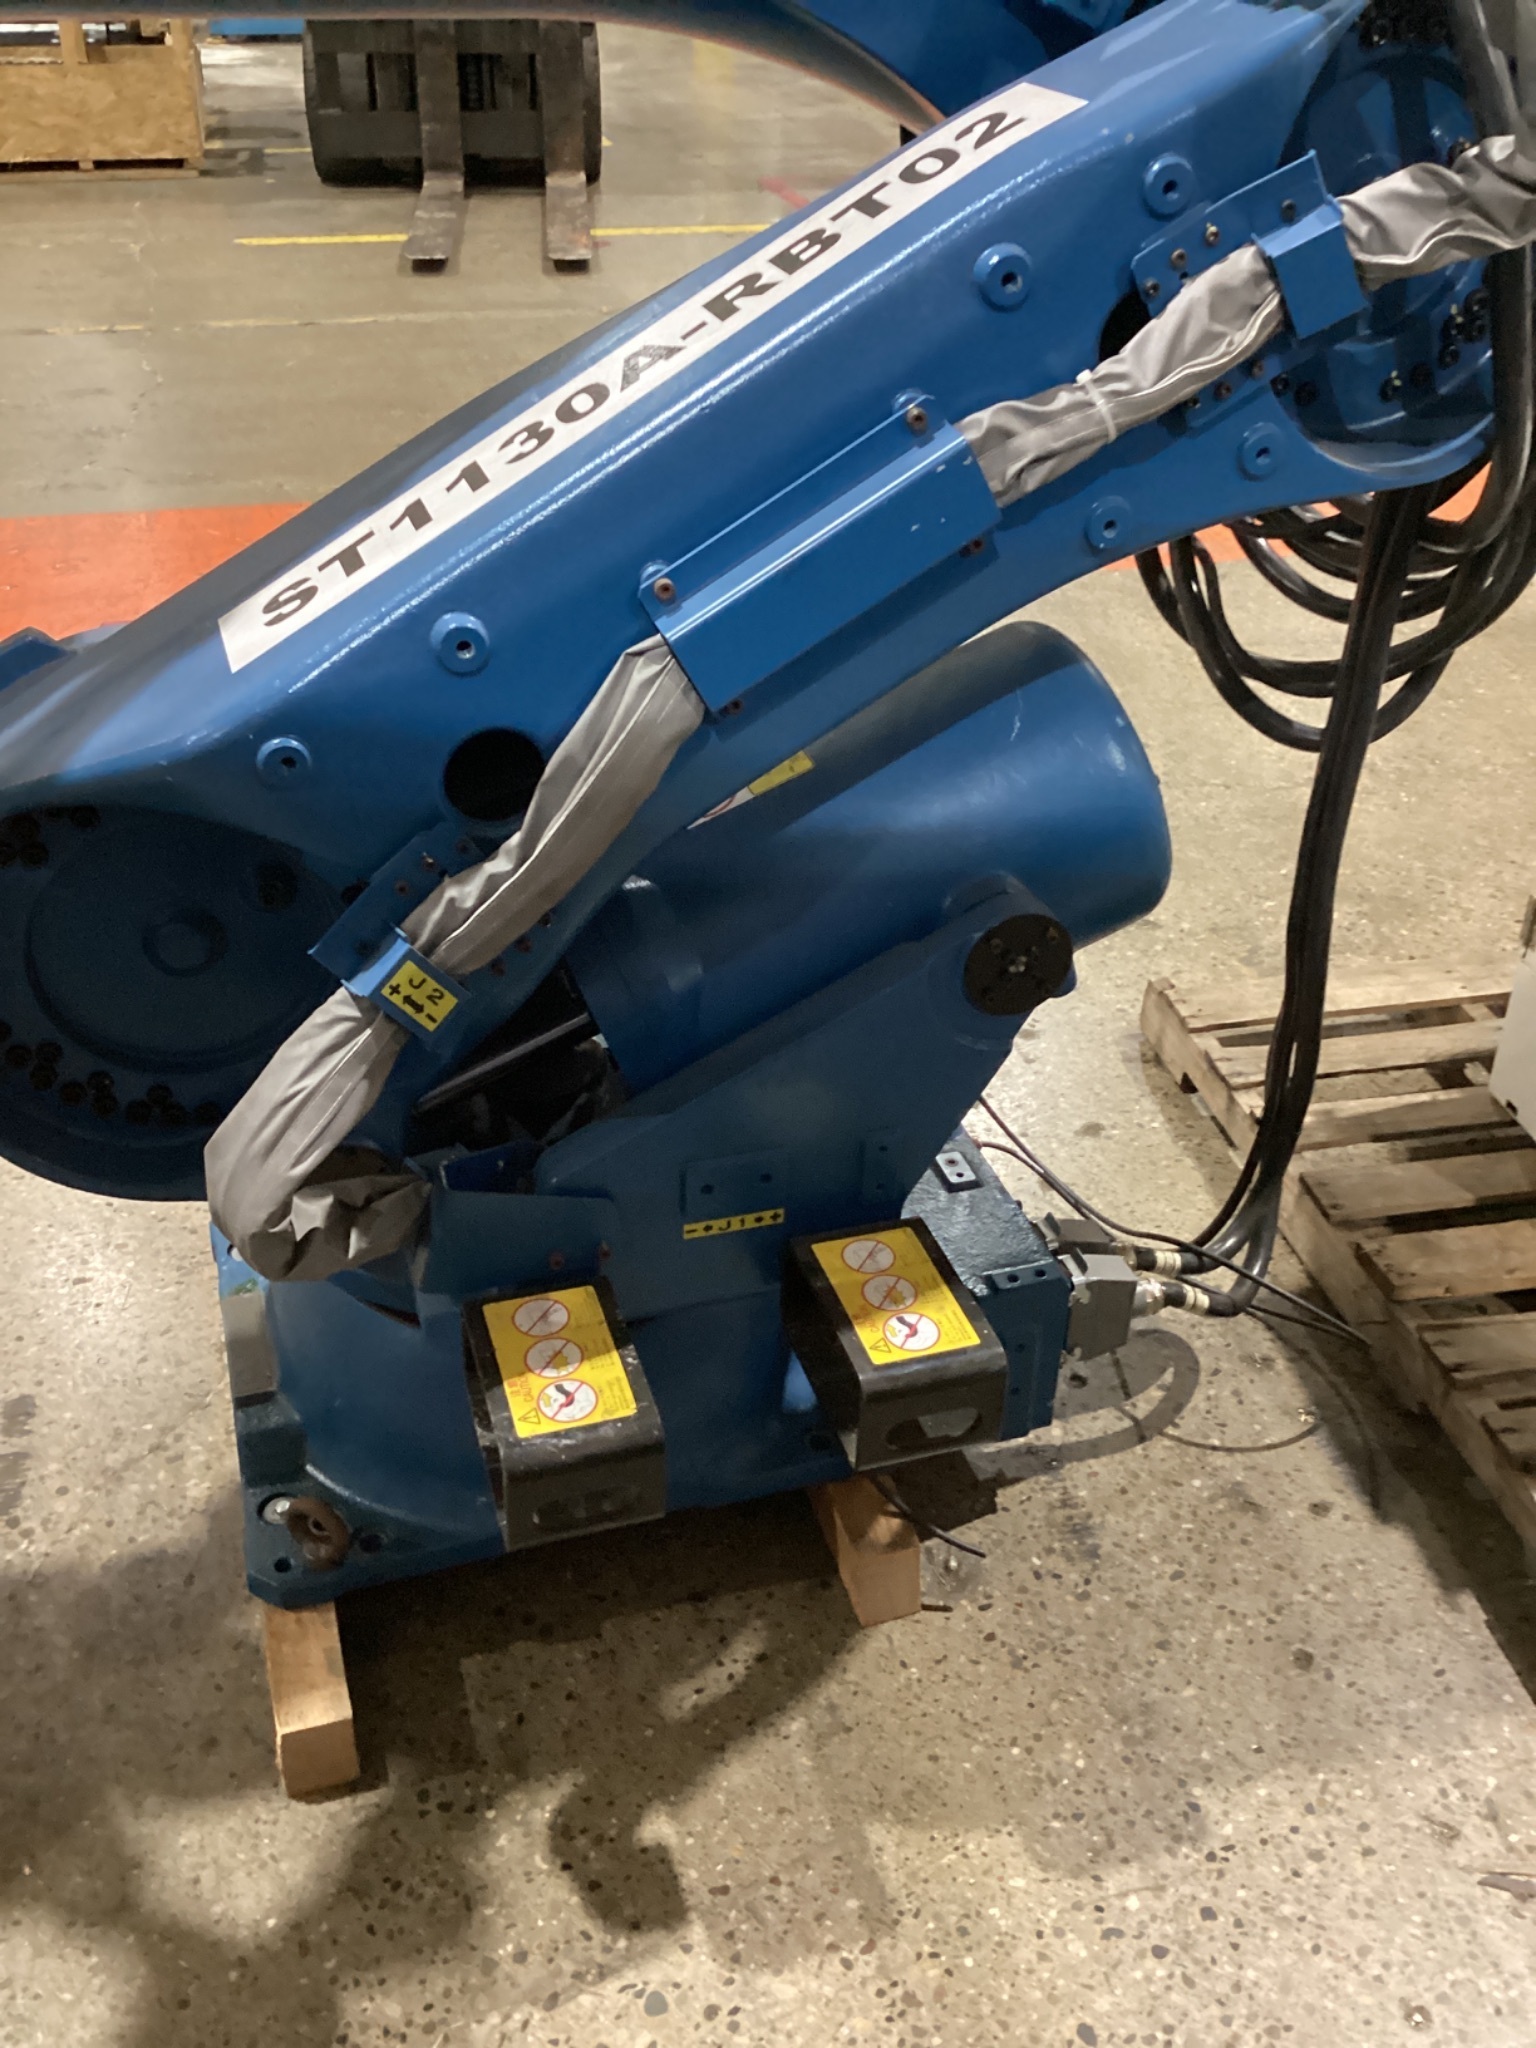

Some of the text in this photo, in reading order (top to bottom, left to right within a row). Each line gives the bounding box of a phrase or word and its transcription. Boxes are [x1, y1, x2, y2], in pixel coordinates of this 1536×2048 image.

[262, 112, 1027, 627] ST1130A-RBT02
[408, 977, 445, 1006] J2
[718, 1217, 746, 1232] J1
